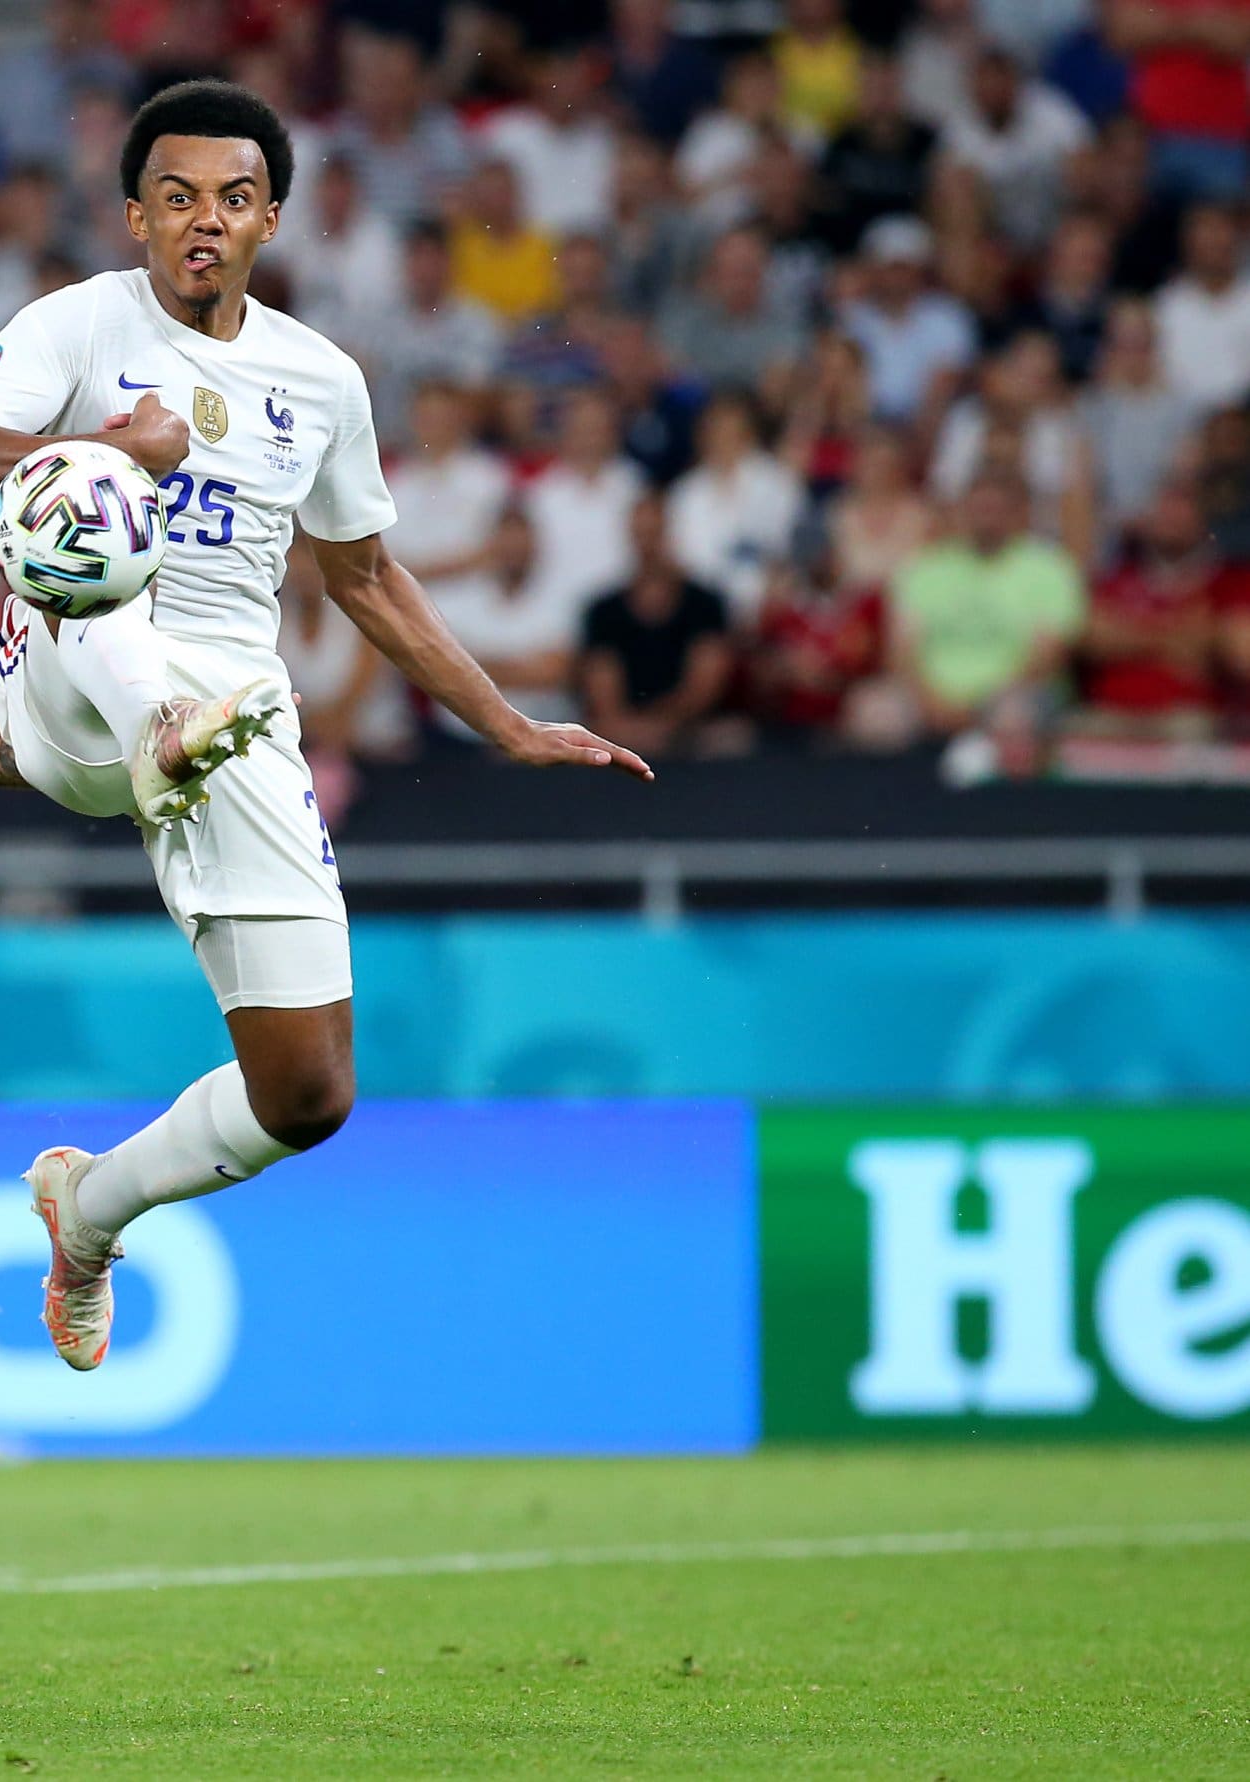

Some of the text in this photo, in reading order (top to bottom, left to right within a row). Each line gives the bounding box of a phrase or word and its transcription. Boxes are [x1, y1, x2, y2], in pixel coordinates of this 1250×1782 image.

[202, 421, 219, 432] FIFA
[157, 471, 237, 546] 25
[848, 1136, 1250, 1421] He
